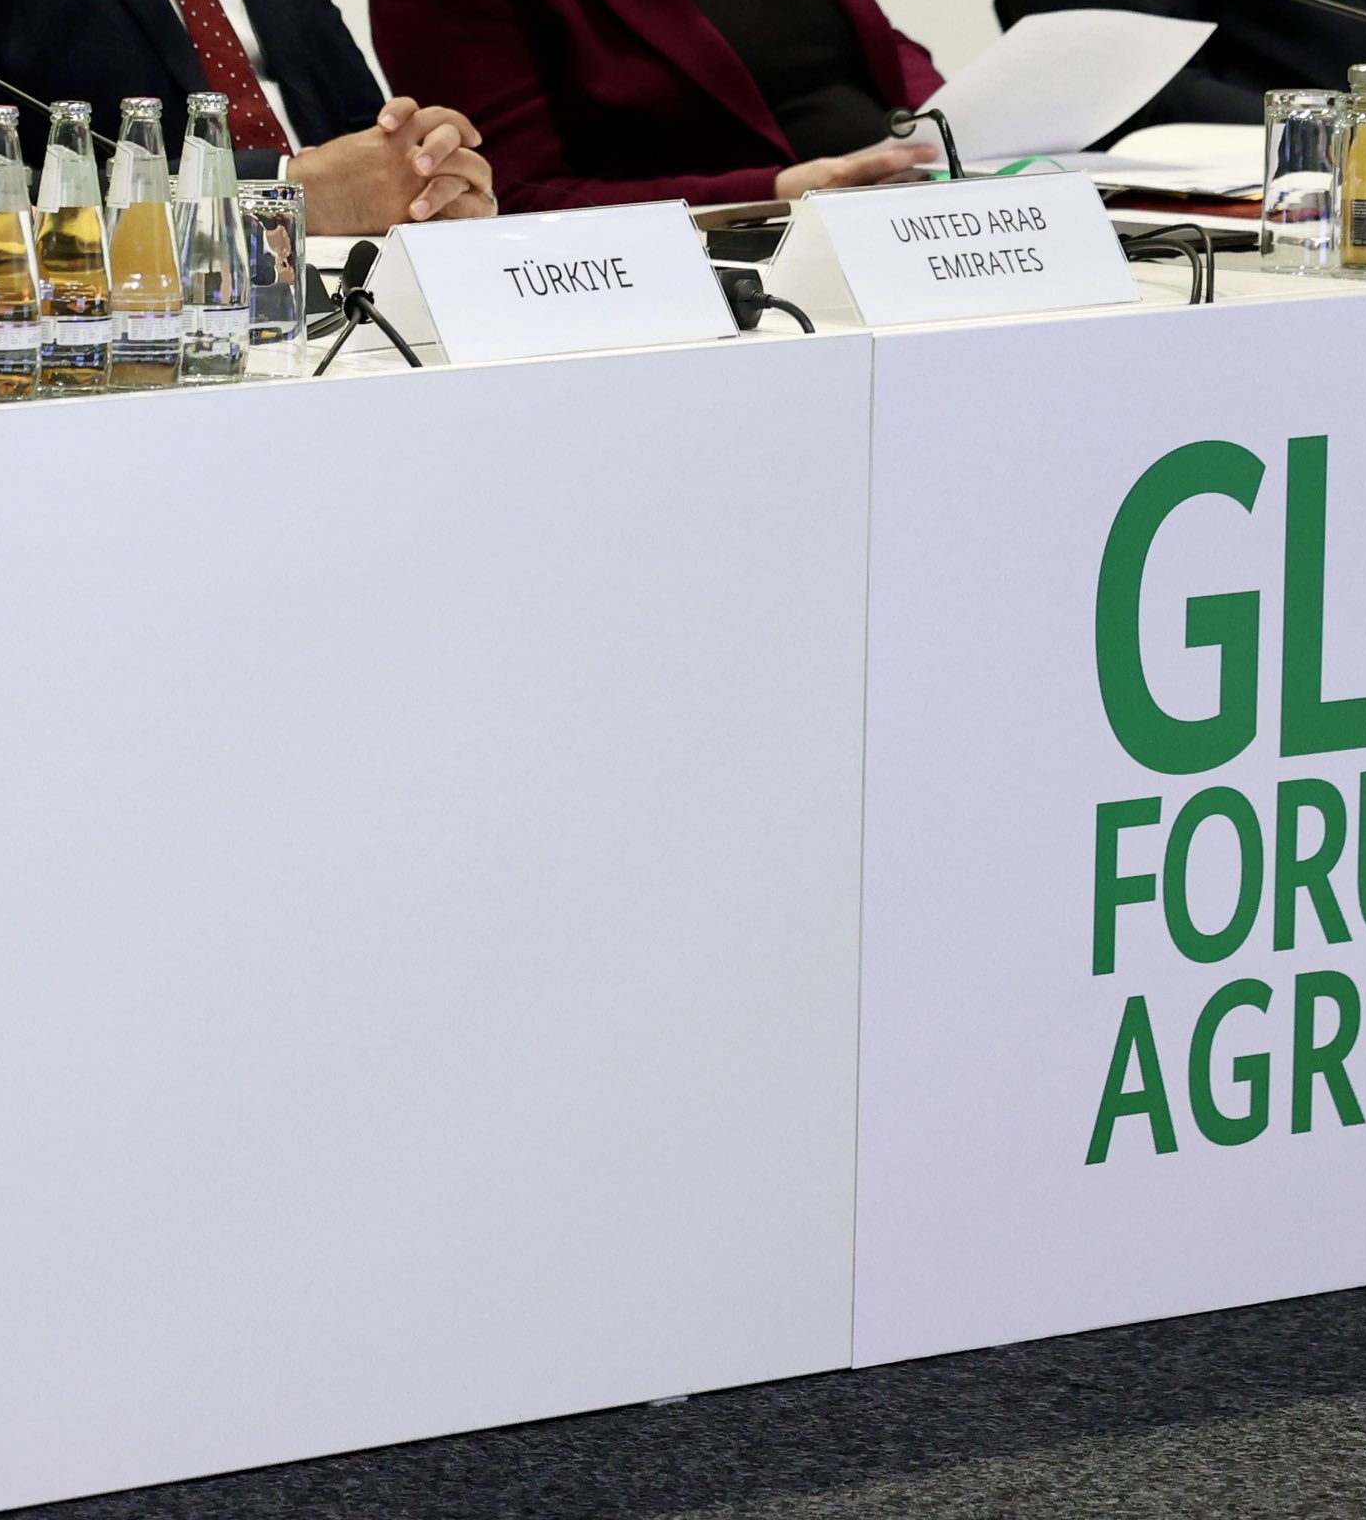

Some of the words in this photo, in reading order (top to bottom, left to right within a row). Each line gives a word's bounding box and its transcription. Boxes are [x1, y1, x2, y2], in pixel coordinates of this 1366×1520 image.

[890, 212, 981, 243] UNITED
[988, 206, 1047, 235] ARAB
[502, 257, 634, 298] TÜRKIYE
[927, 246, 1044, 281] EMIRATES
